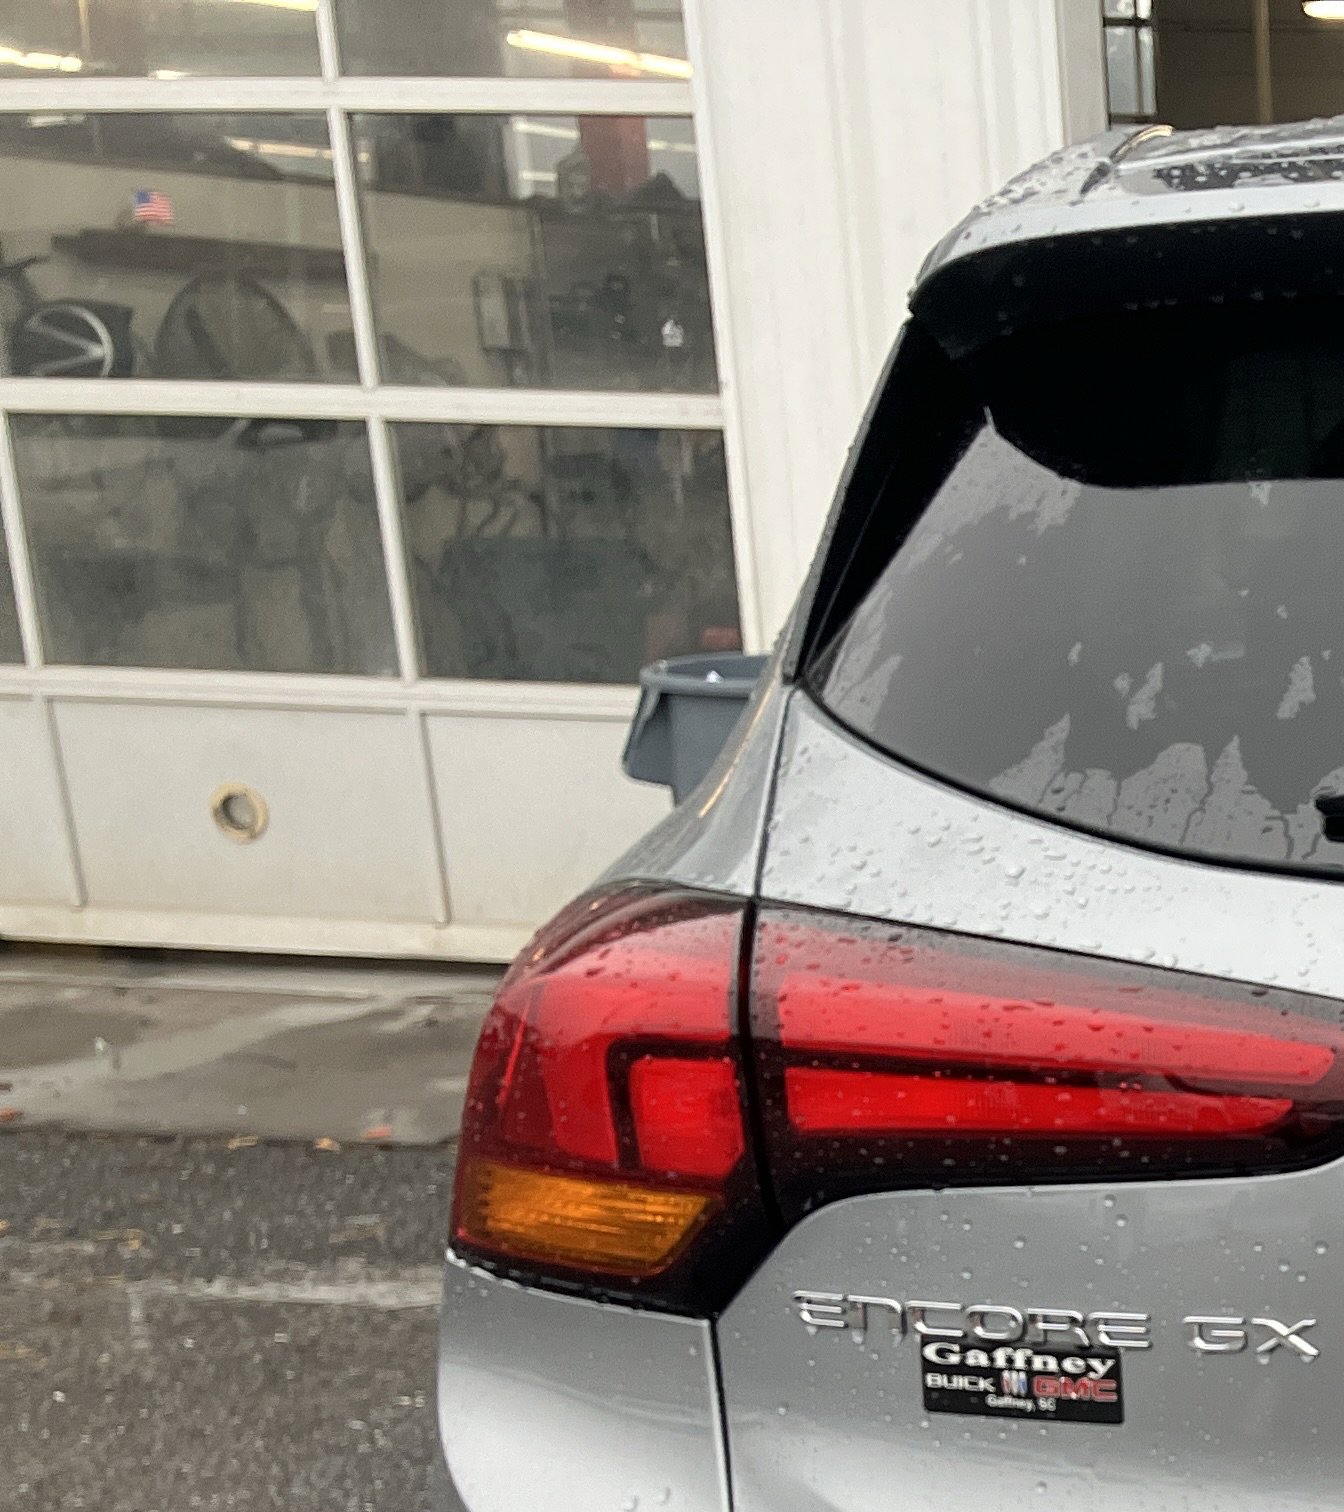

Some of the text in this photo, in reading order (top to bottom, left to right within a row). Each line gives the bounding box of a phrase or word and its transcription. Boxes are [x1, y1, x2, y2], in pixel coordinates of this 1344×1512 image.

[793, 1290, 1320, 1357] ENCORE GX
[922, 1341, 1116, 1380] Gaffney
[925, 1372, 1118, 1403] BUICK GMC
